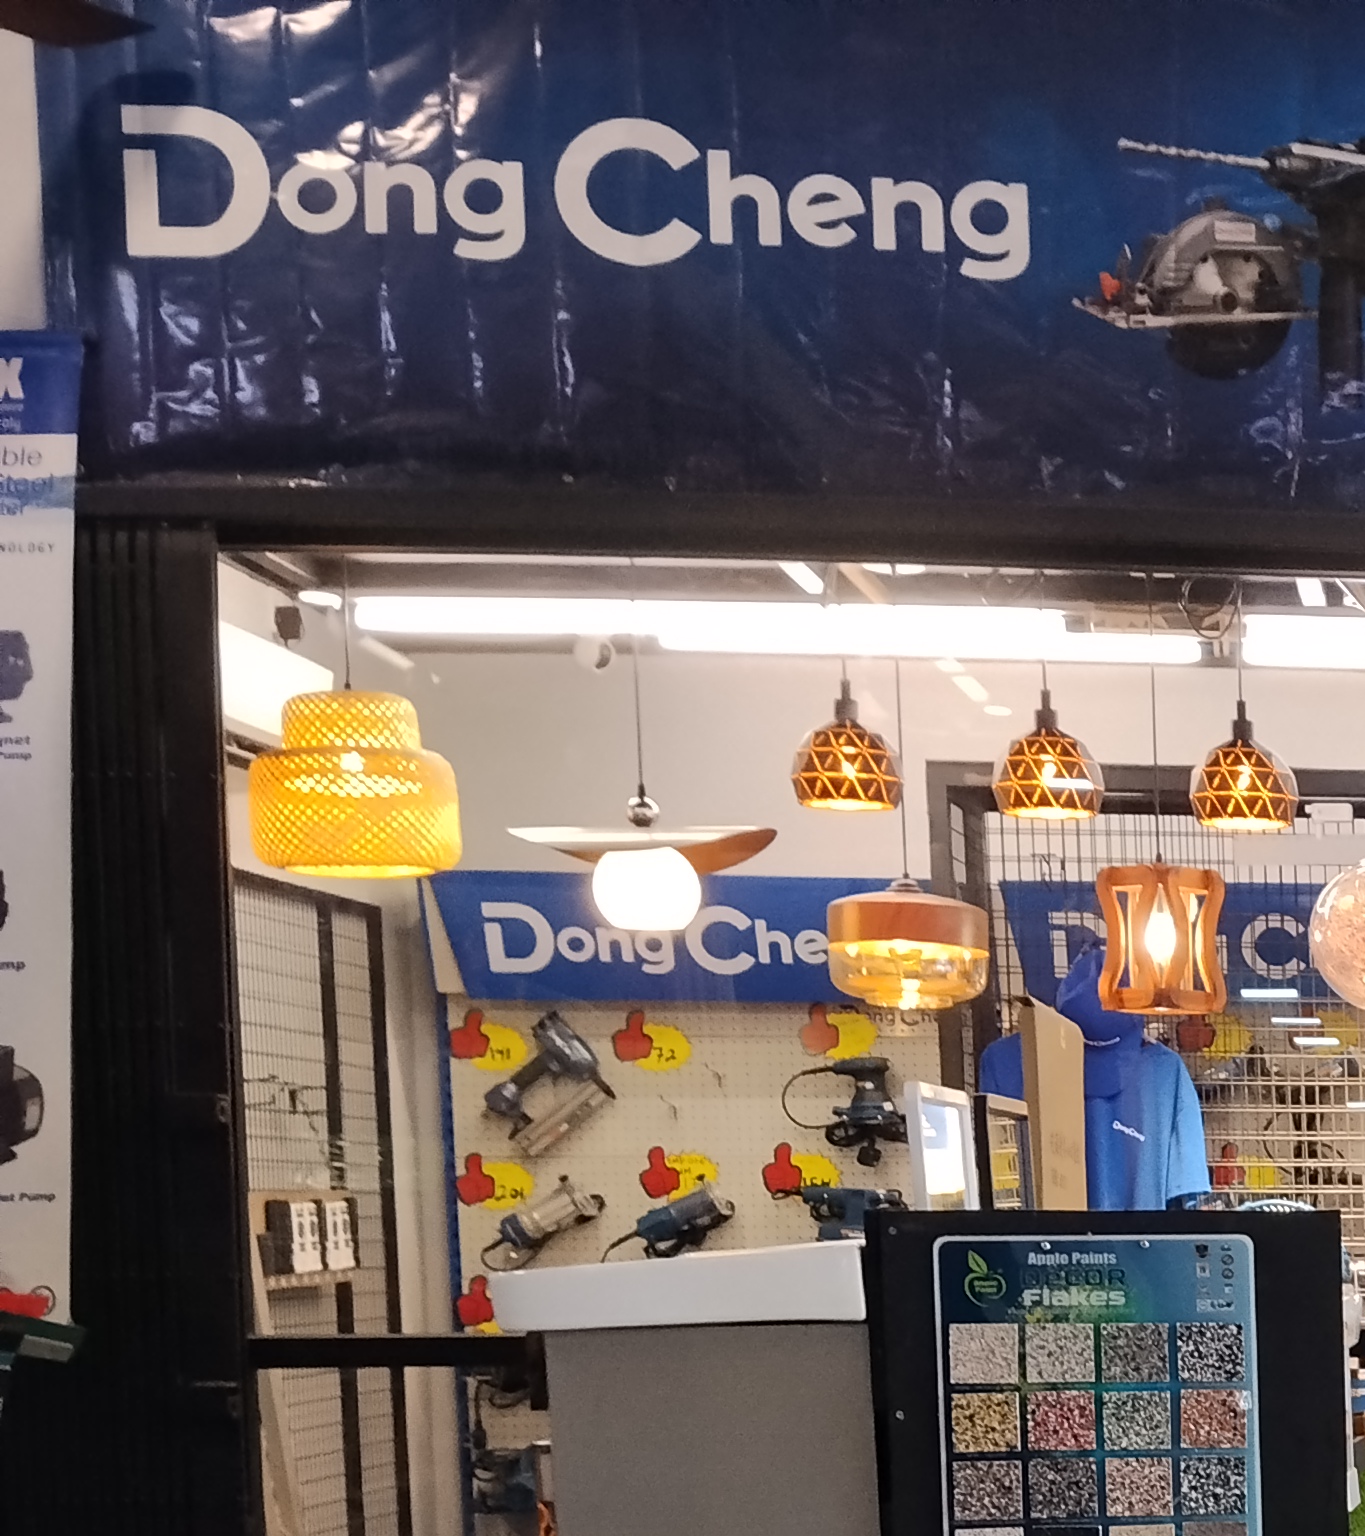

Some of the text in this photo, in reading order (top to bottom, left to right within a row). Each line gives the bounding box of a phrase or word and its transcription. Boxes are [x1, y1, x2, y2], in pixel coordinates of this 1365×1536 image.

[0, 446, 43, 467] ble
[1071, 1251, 1118, 1265] Paints
[1021, 1285, 1127, 1307] Flakes
